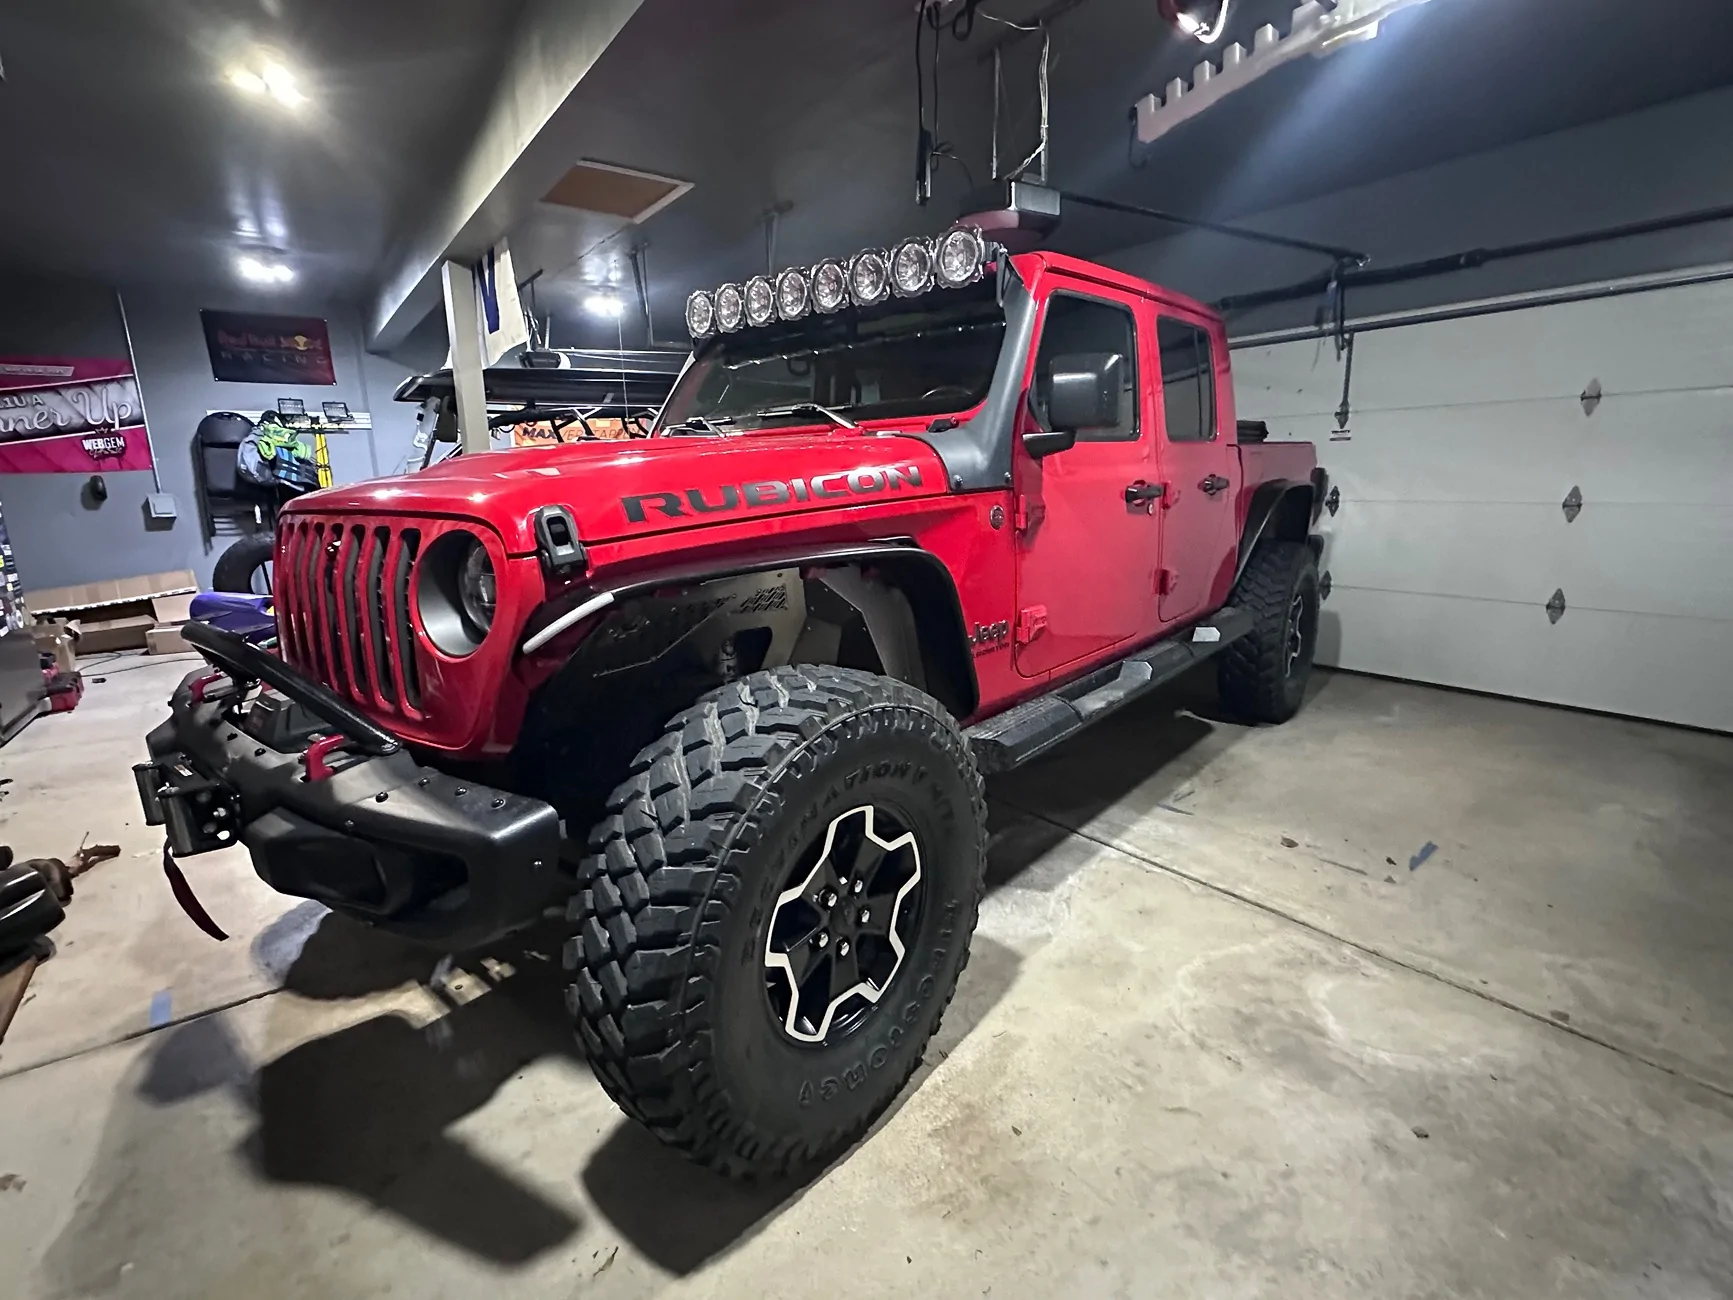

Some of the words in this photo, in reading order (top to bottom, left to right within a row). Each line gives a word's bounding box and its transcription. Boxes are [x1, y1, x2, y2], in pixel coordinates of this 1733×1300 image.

[32, 394, 44, 405] A
[72, 387, 132, 430] Up
[82, 436, 125, 450] WEBGEM
[522, 427, 557, 439] MAX
[620, 465, 923, 524] RUBICON
[968, 620, 1008, 646] Jeep
